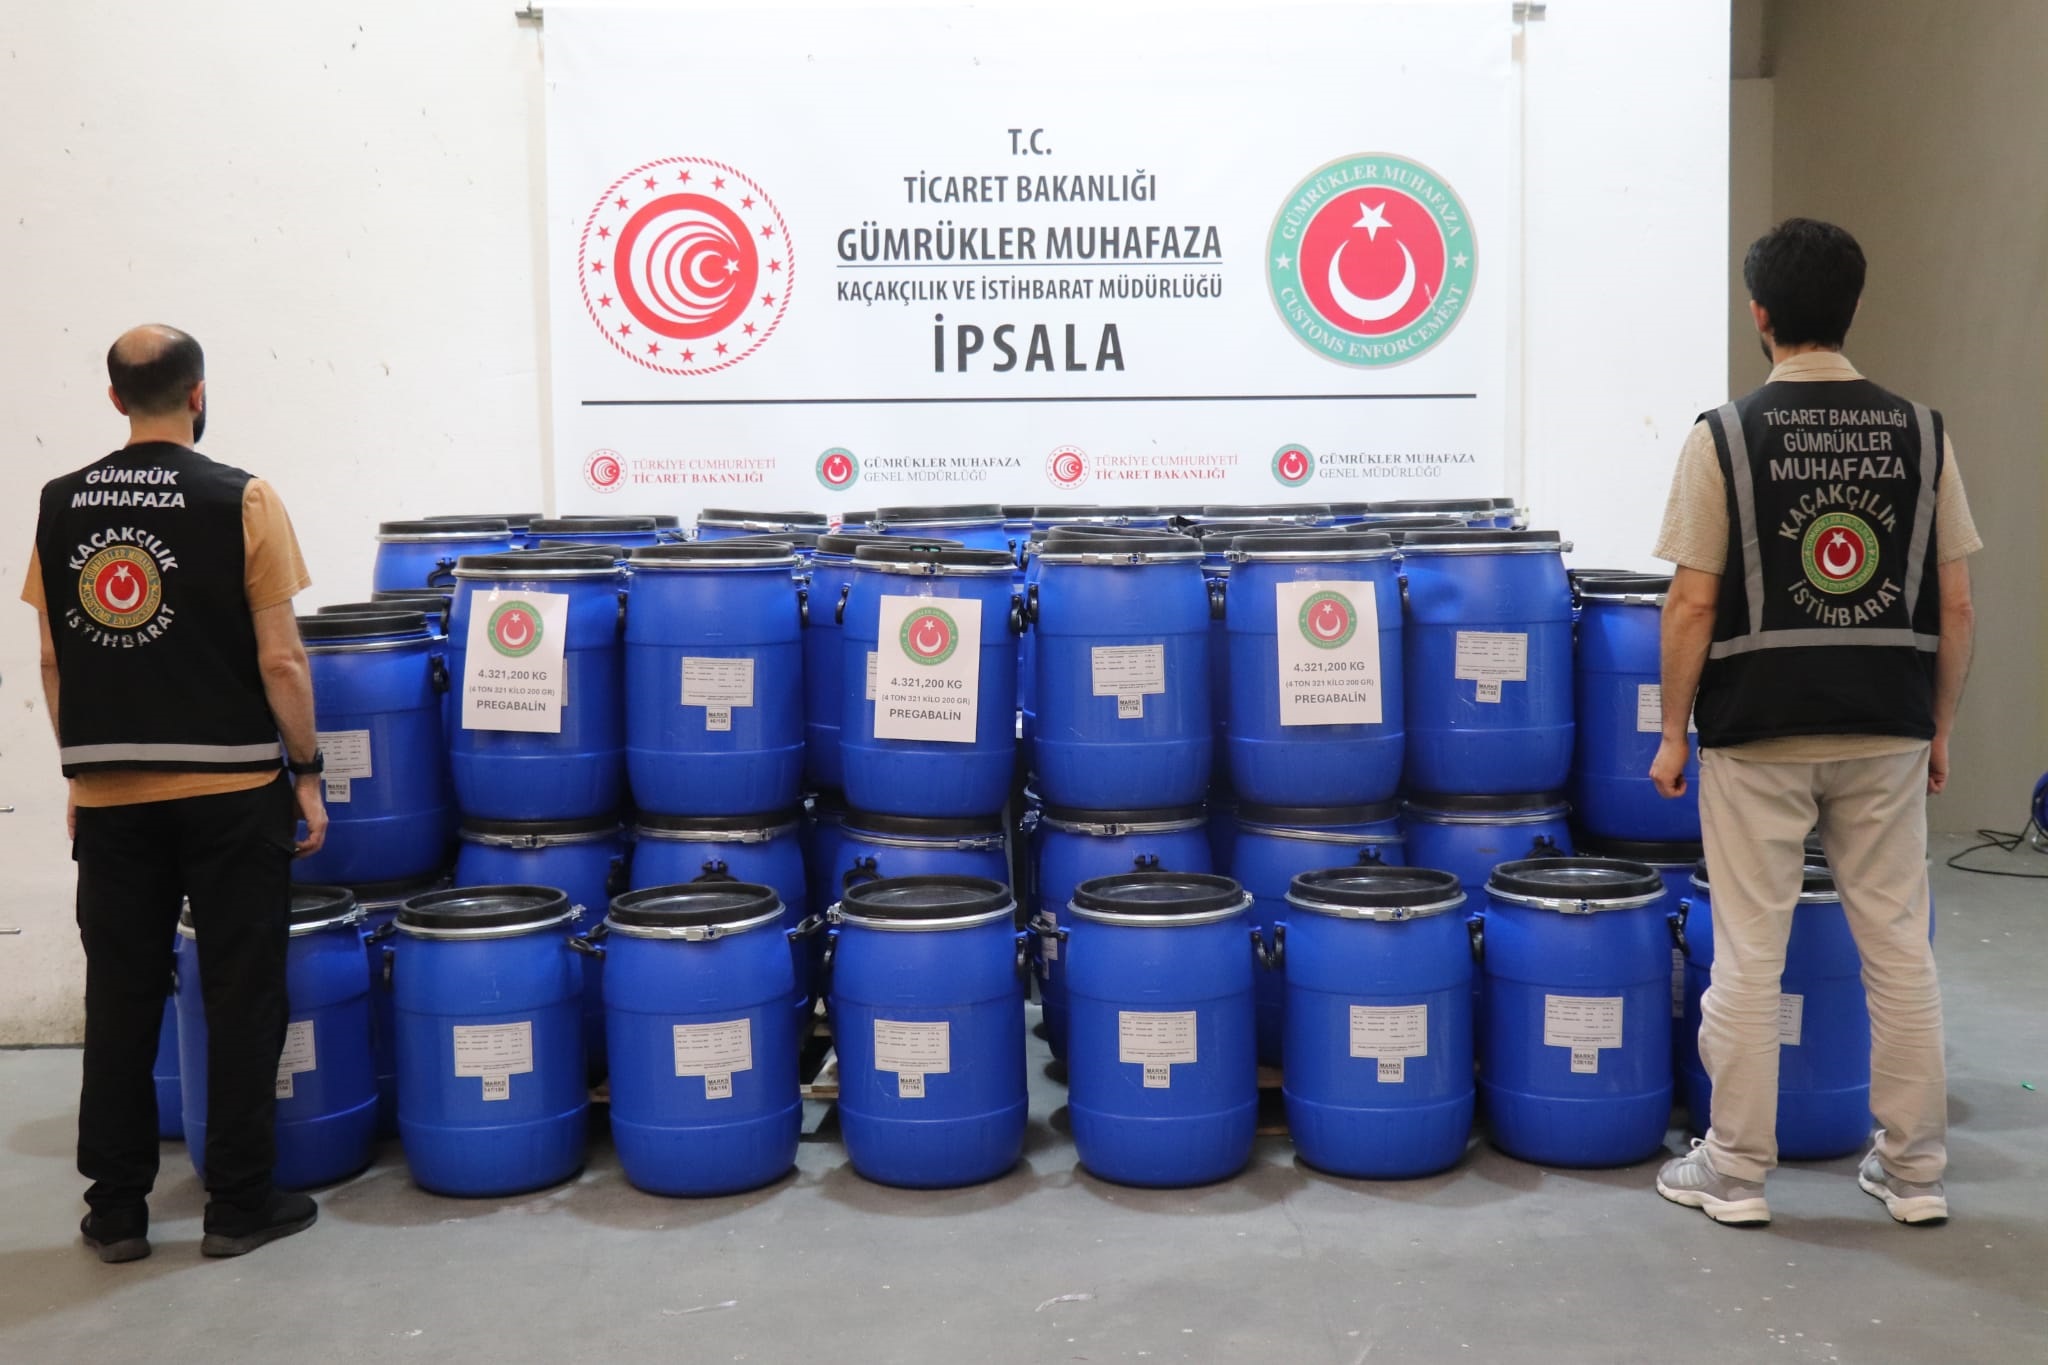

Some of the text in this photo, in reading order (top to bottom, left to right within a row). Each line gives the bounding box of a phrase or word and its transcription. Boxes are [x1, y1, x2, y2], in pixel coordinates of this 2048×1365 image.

[1007, 128, 1053, 155] T.C.
[903, 168, 1157, 203] TİCARET BAKANLIĞI
[1281, 163, 1462, 240] GÜMRÜKLER MUHAFAZA
[836, 219, 1223, 262] GÜMRÜKLER MUHAFAZA
[836, 272, 1223, 307] KAÇAKÇILIK VE İSTİHBARAT MÜDÜRLÜĞÜ
[1280, 283, 1464, 359] CUSTOMS ENFORCEMENT
[933, 312, 1126, 373] İPSALA
[1763, 407, 1908, 429] TİCARET BAKANLIĞI
[1782, 428, 1893, 453] GÜMRÜKLER
[631, 456, 776, 471] TÜRKİYE CUMHURİYETİ
[863, 455, 1022, 469] GÜMRÜKLER MUHAFAZA
[1095, 452, 1239, 467] TÜRKİYE CUMHURİYETİ
[1319, 452, 1476, 465] GÜMRÜKLER MUHAFAZA
[85, 465, 180, 485] GÜMRÜK
[863, 469, 987, 483] GENEL MÜDÜRLÜĞÜ
[1095, 467, 1226, 481] TİCARET BAKANLIĞI
[1319, 465, 1441, 479] GENEL MÜDÜRLÜĞÜ
[1769, 456, 1907, 481] MUHAFAZA
[631, 471, 764, 484] TİCARET BAKANLIĞI
[71, 490, 186, 509] MUHAFAZA
[1778, 483, 1897, 542] KAÇAKÇILIK
[68, 526, 179, 573] KAÇAKÇILIK
[1787, 577, 1902, 627] İSTİHBARAT
[478, 669, 548, 681] 4.321,200 KG
[1293, 661, 1366, 673] 4.321,200 KG
[890, 677, 963, 690] 4.321,200 KG
[476, 699, 547, 712] PREGABALİN
[890, 694, 907, 702] TON
[1294, 692, 1367, 704] PREGABALİN
[889, 708, 962, 721] PREGABALİN
